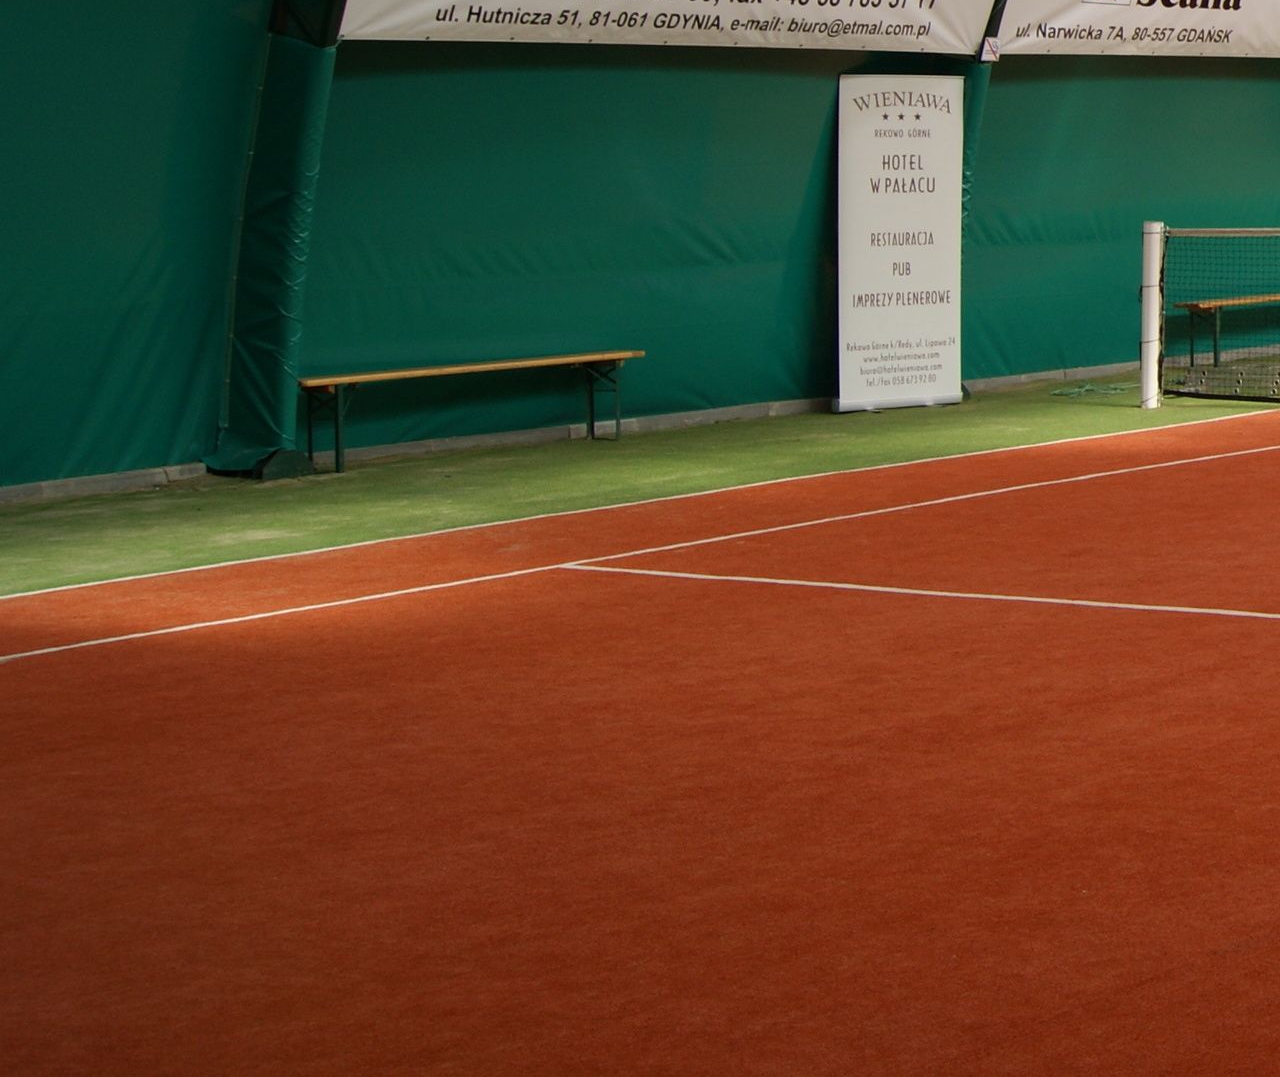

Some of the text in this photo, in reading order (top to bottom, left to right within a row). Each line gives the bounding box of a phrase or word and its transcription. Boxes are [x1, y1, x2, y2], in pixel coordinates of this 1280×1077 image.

[435, 5, 930, 39] ul. Hutnicza 51, 81-061 GDYNIA, e-mail: biuro@etmal.com.pl
[1016, 22, 1233, 43] ul. Narwicka 7A, 80-557 GDAŃSK
[852, 91, 952, 114] WIENIAWA
[874, 129, 904, 138] REKOWO
[882, 154, 924, 171] HOTEL
[870, 177, 936, 194] W PAŁACU
[870, 231, 934, 247] RESTAURACJA
[892, 261, 911, 276] PUB
[852, 289, 951, 308] IMPREZY PLENEROWE
